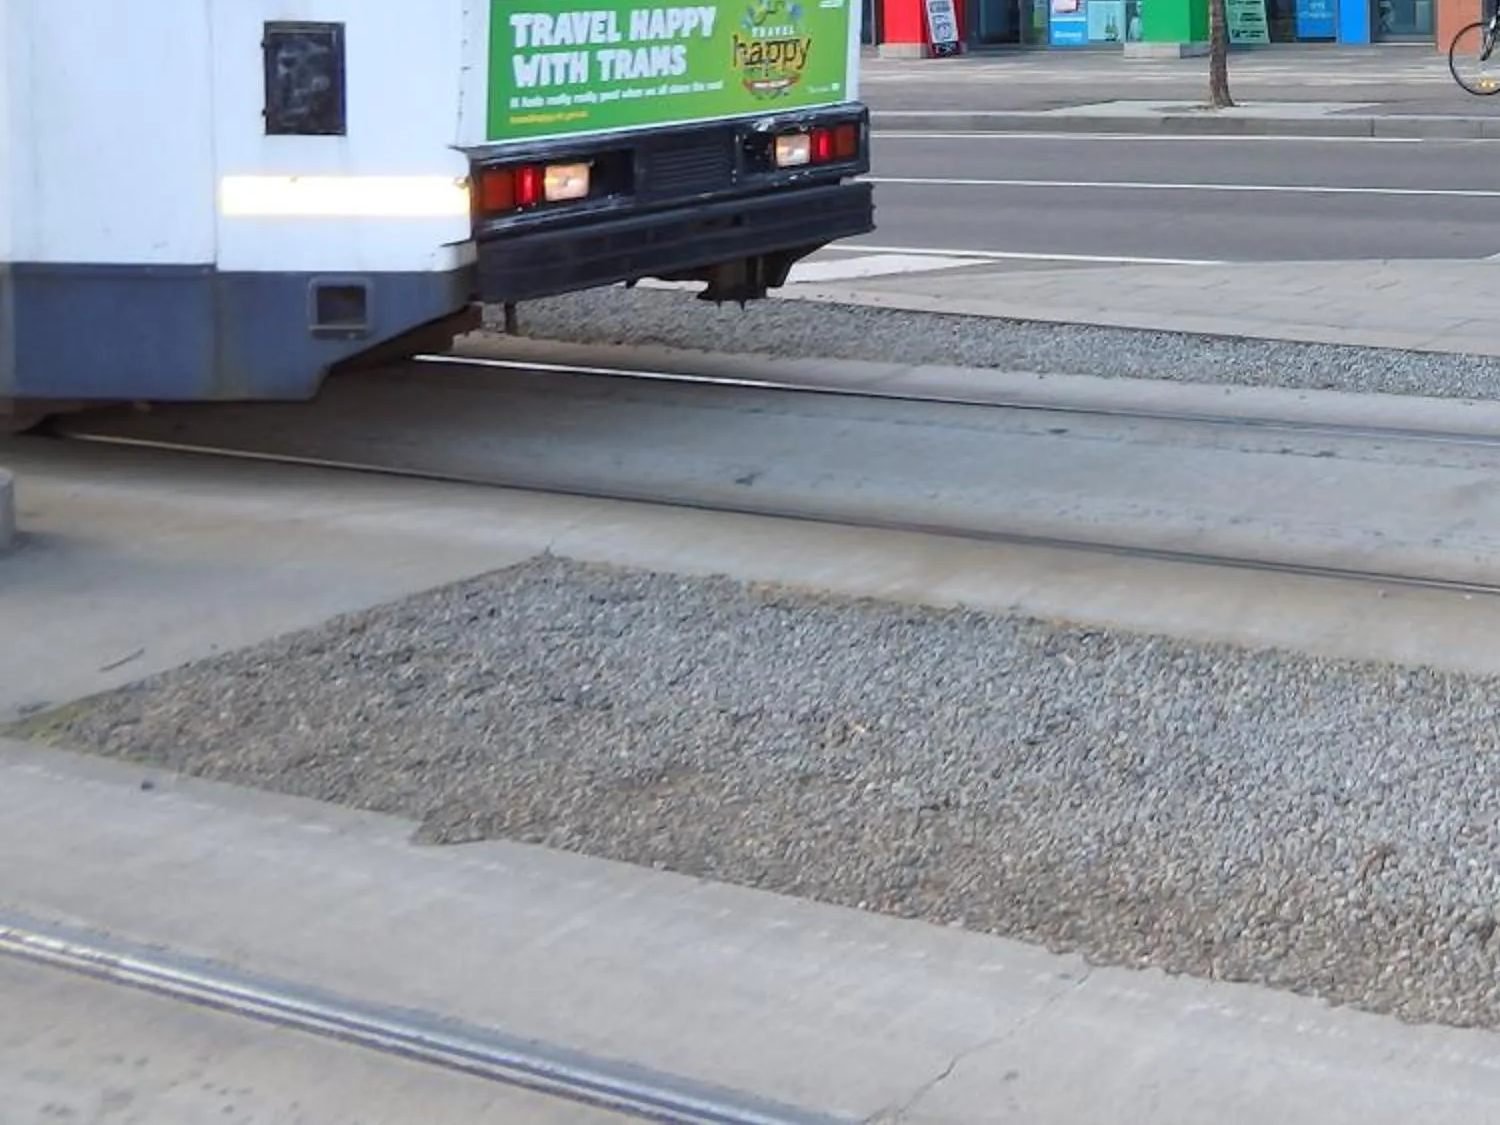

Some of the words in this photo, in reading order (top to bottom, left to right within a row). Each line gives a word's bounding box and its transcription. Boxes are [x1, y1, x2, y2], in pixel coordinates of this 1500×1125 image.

[509, 10, 621, 48] TRAVEL
[629, 6, 718, 41] HAPPY
[512, 51, 590, 89] WITH
[596, 44, 688, 82] TRAMS
